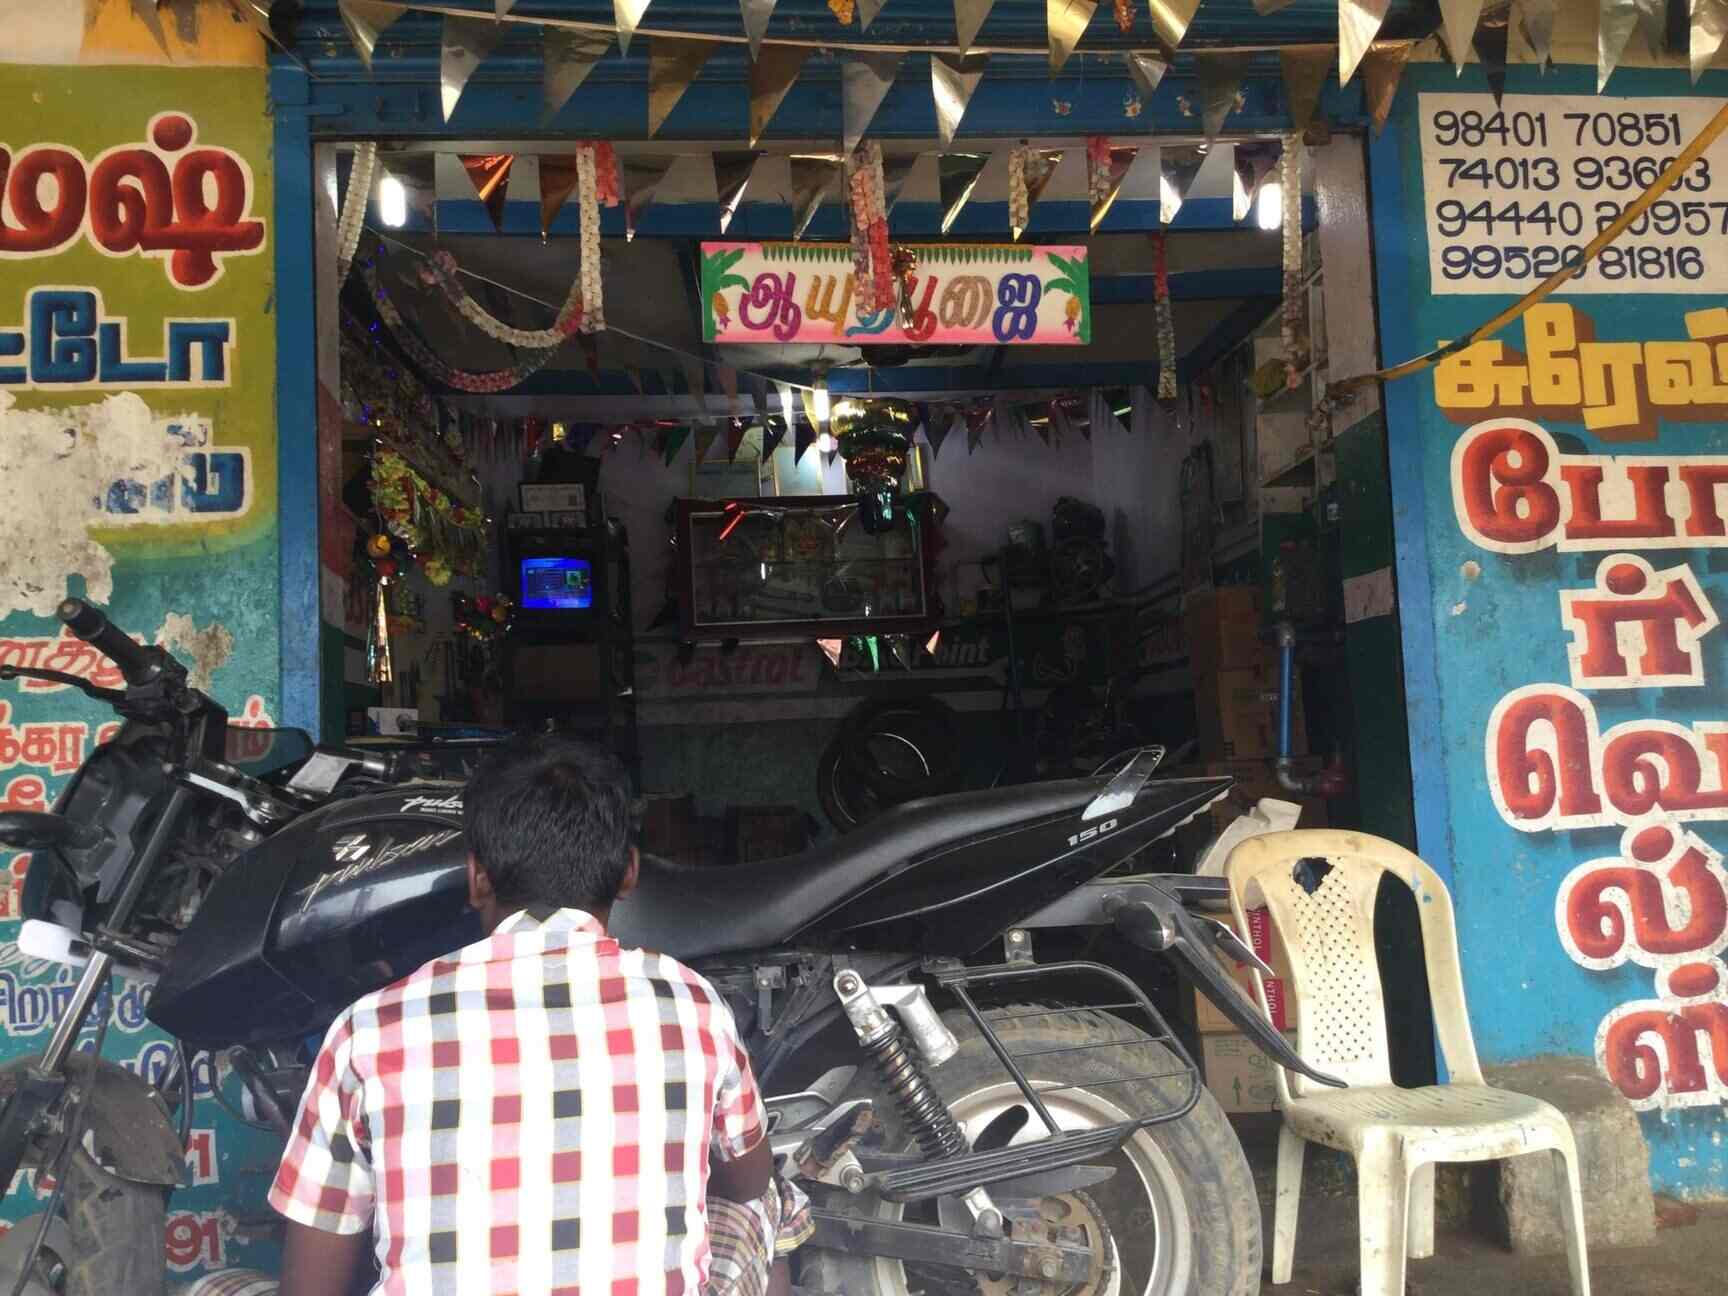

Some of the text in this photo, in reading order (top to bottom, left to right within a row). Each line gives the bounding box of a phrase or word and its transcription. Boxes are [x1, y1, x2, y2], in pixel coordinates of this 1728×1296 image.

[1433, 110, 1681, 147] 98401 70851
[1438, 156, 1560, 191] 74013
[1435, 199, 1583, 237] 94440
[1598, 246, 1705, 280] 81816
[1067, 818, 1118, 847] 150
